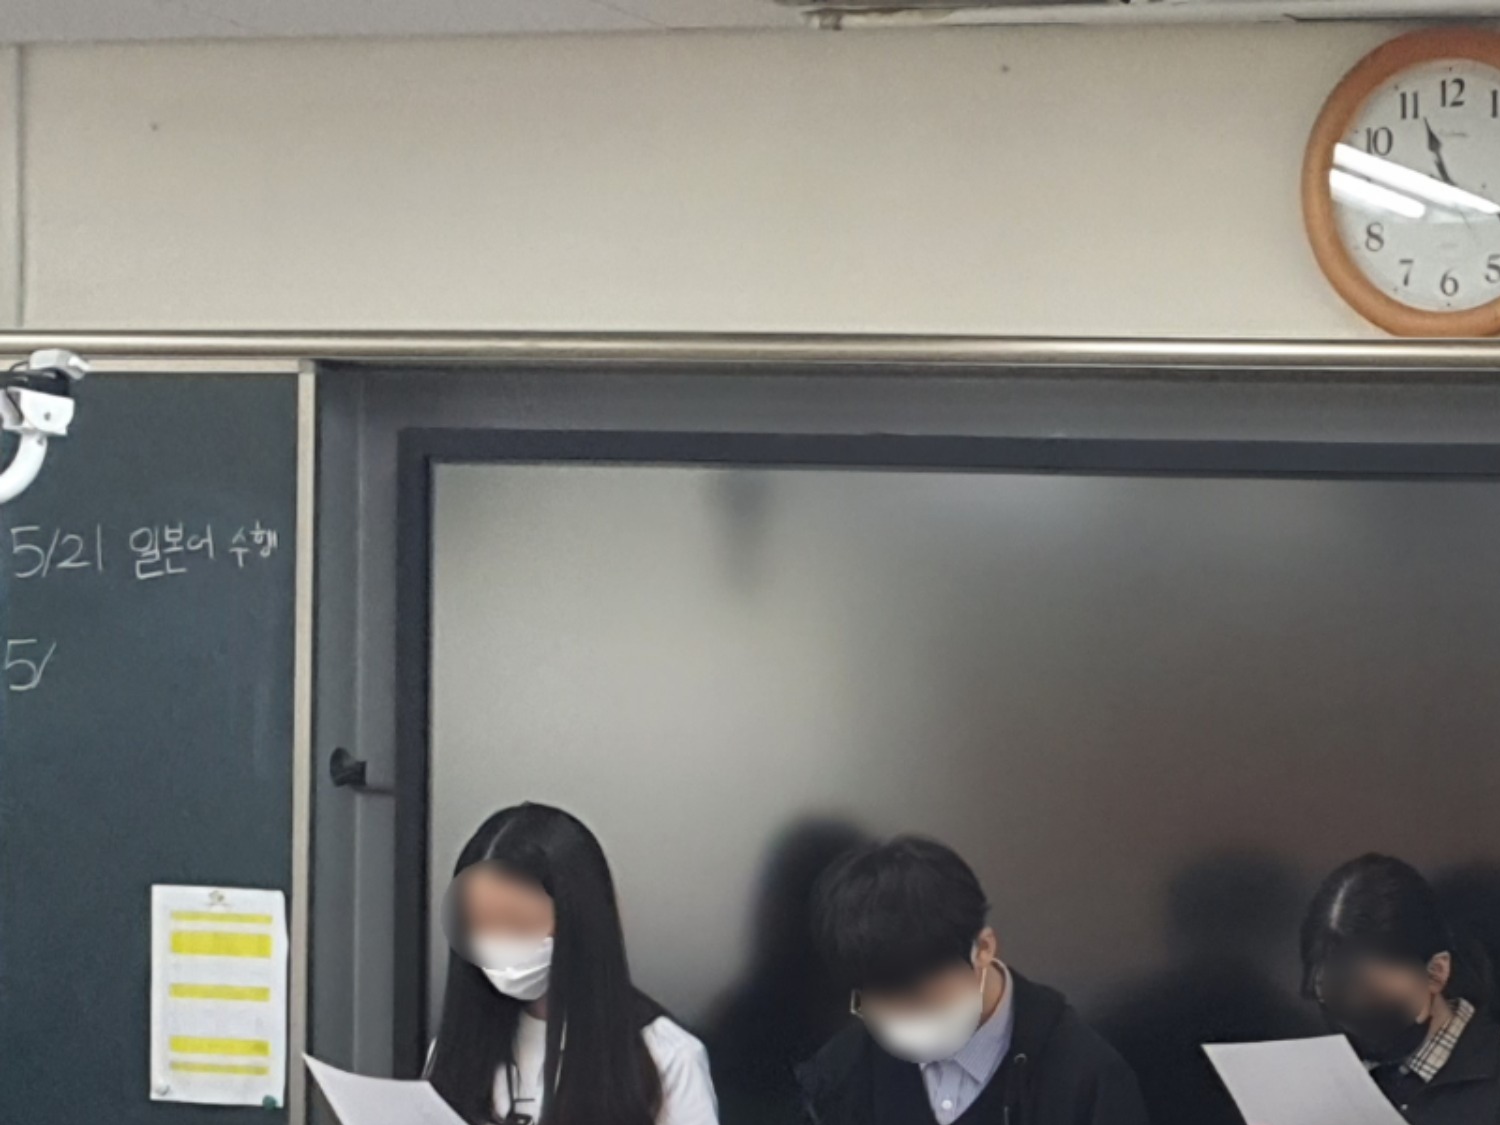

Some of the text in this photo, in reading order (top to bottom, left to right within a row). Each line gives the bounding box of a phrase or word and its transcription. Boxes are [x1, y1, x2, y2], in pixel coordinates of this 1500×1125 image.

[1400, 91, 1419, 119] 11
[1440, 78, 1466, 107] 12
[1490, 89, 1498, 118] 1
[1365, 126, 1393, 156] 10
[1365, 222, 1385, 252] 8
[1399, 259, 1414, 287] 7
[1440, 270, 1459, 297] 6
[10, 519, 280, 581] 5/21 일본어 수행
